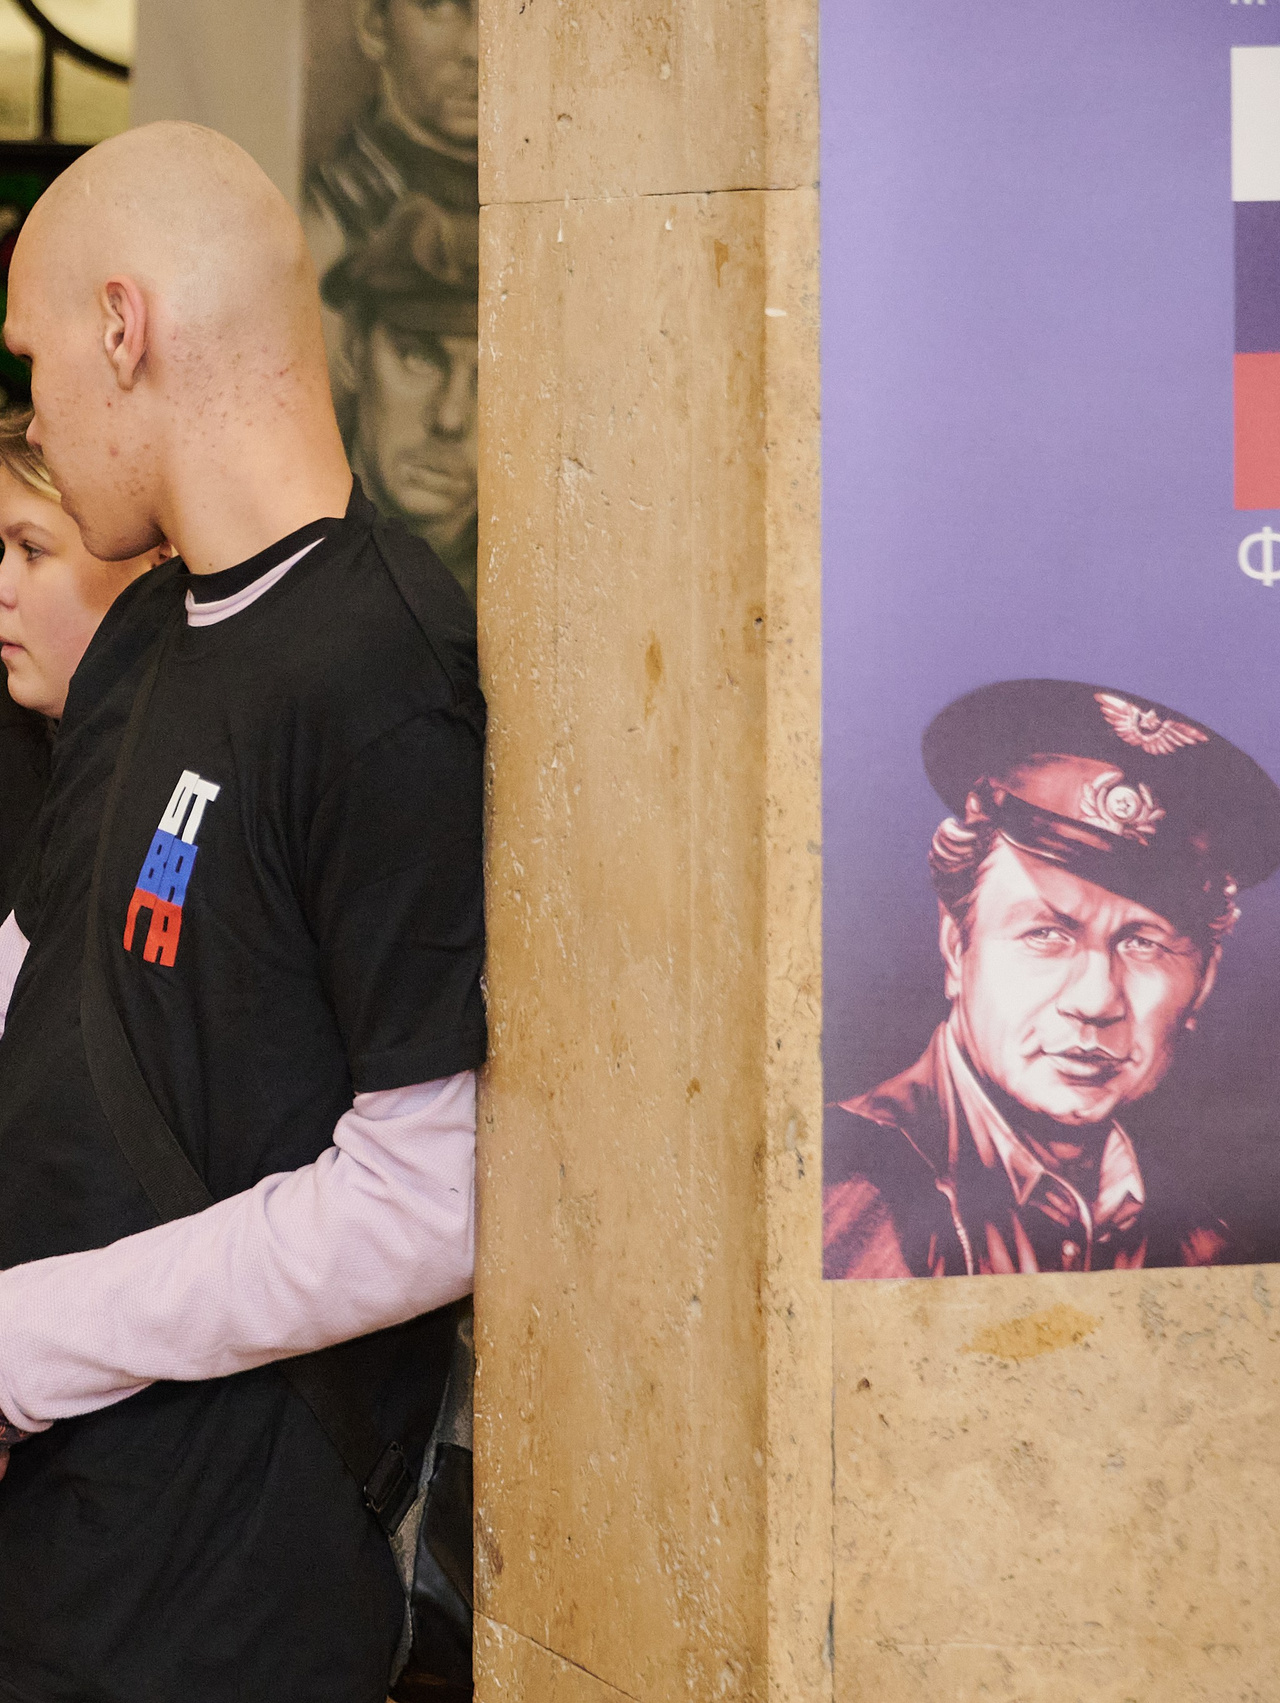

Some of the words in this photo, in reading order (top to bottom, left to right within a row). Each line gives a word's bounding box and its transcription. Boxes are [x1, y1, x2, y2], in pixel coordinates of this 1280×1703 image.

[158, 769, 220, 845] ОТ
[136, 828, 198, 907] ВА
[123, 887, 183, 967] ГА
